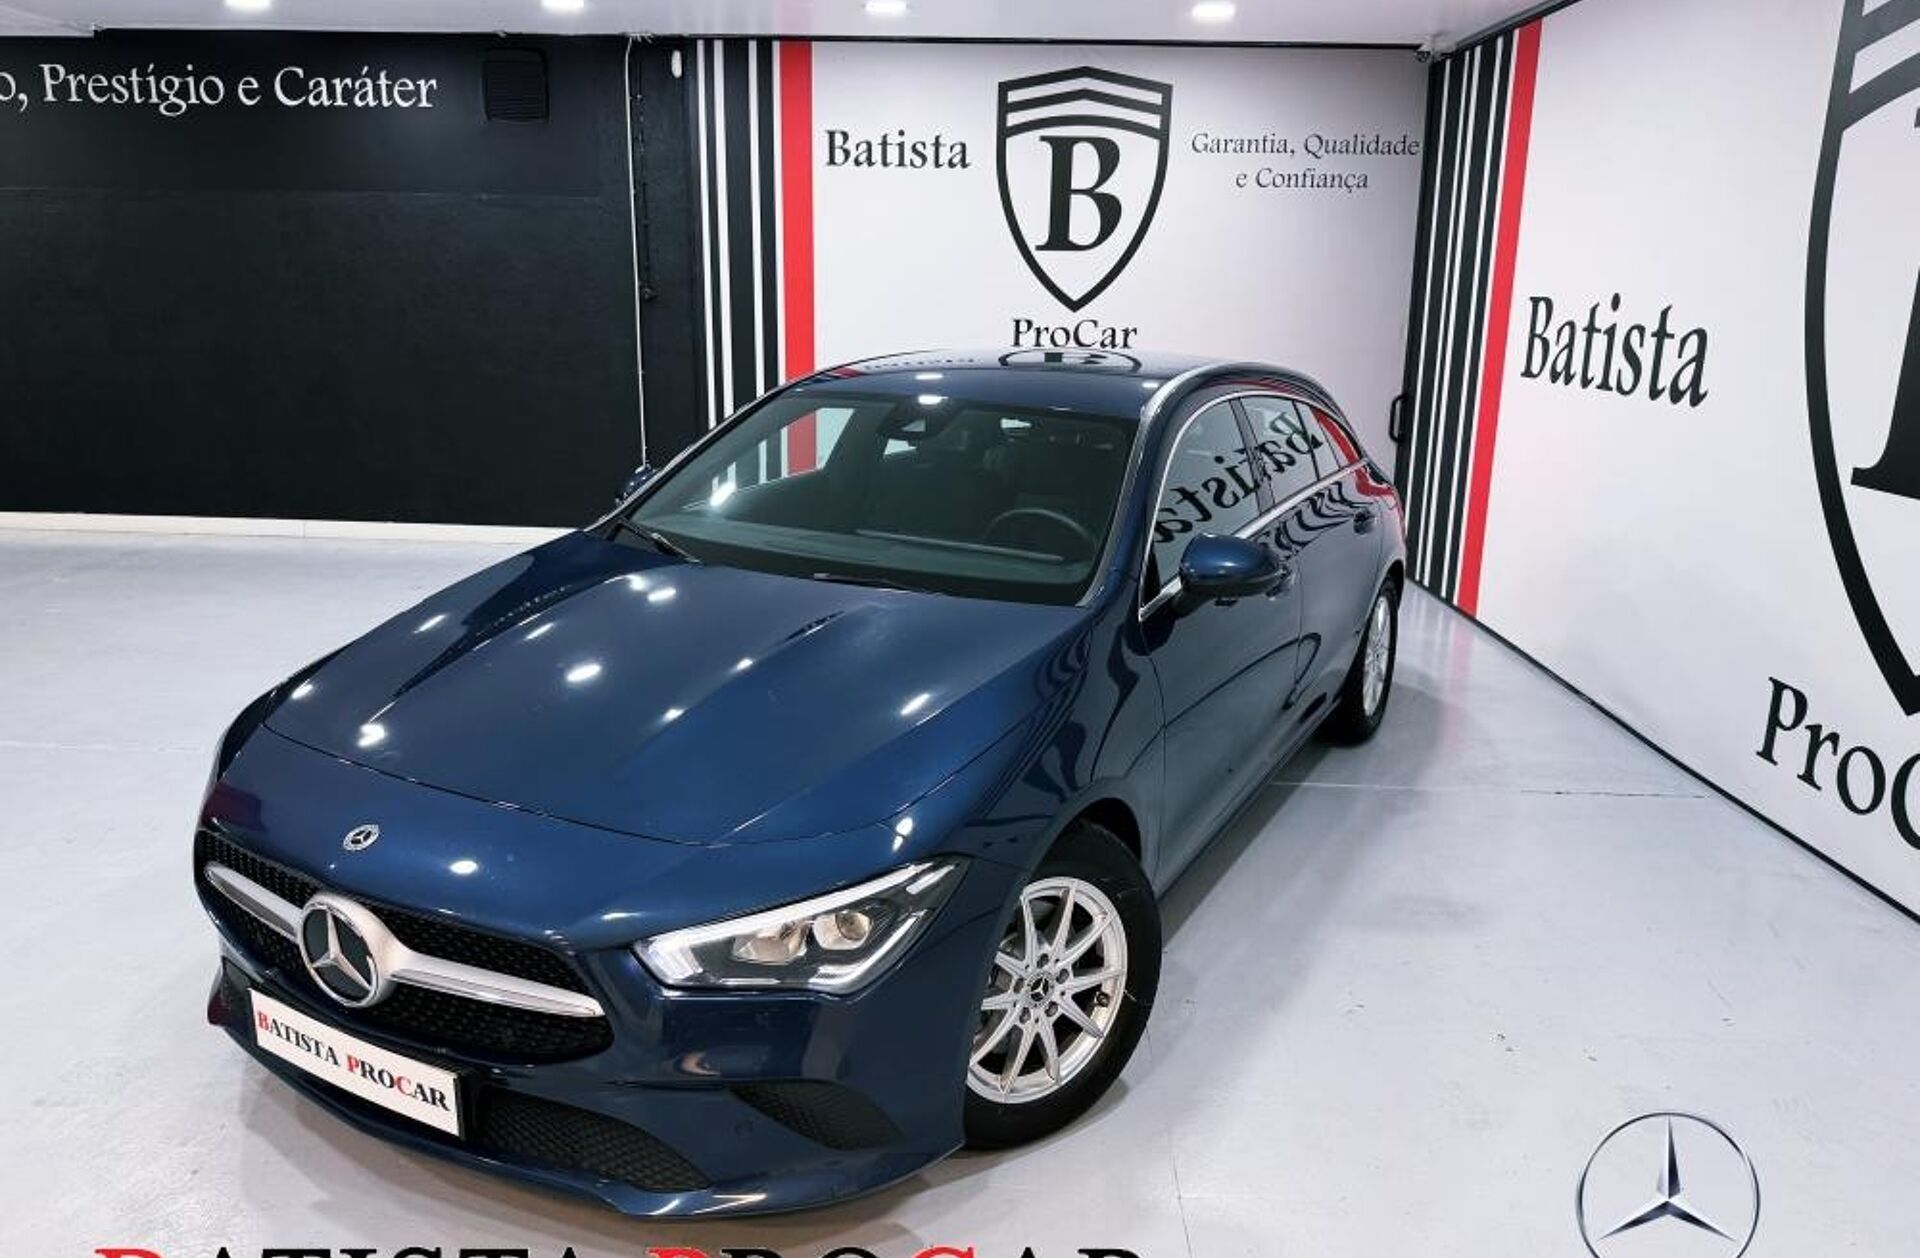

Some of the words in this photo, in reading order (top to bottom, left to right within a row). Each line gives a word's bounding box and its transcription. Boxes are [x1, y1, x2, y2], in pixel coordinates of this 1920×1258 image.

[38, 63, 226, 117] Prestígio
[237, 76, 262, 107] e
[273, 66, 438, 109] Caráter
[825, 129, 970, 170] Batista
[1191, 132, 1296, 157] Garantia,
[1303, 132, 1421, 160] Qualidade
[1035, 135, 1123, 252] B
[1235, 173, 1248, 189] e
[1255, 167, 1369, 194] Confiança
[1012, 318, 1138, 349] ProCar
[1520, 292, 1710, 409] Batista
[256, 1011, 341, 1067] BATISTA
[346, 1054, 450, 1112] PROCAR
